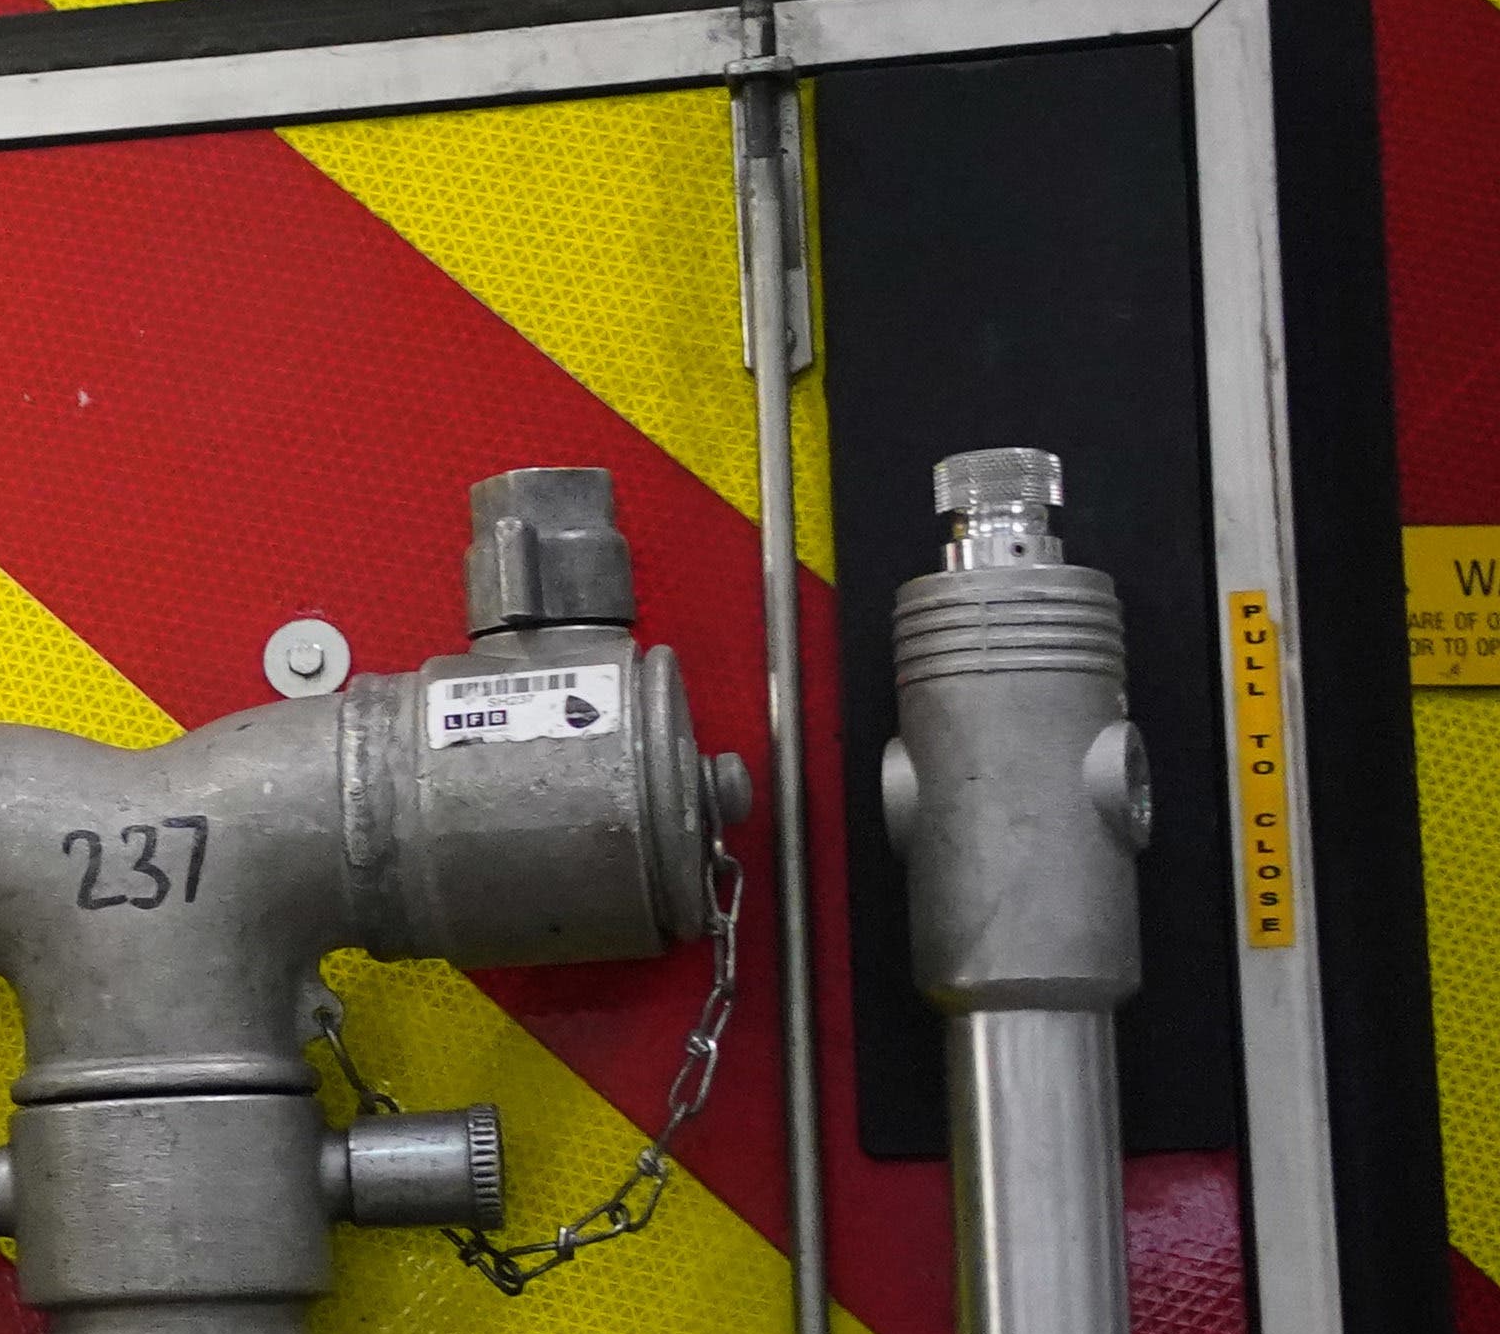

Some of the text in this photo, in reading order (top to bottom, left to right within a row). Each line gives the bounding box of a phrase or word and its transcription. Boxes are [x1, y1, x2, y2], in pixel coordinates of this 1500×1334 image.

[1453, 558, 1500, 596] W
[1242, 603, 1283, 934] PULL TO CLOSE
[61, 814, 209, 911] 237
